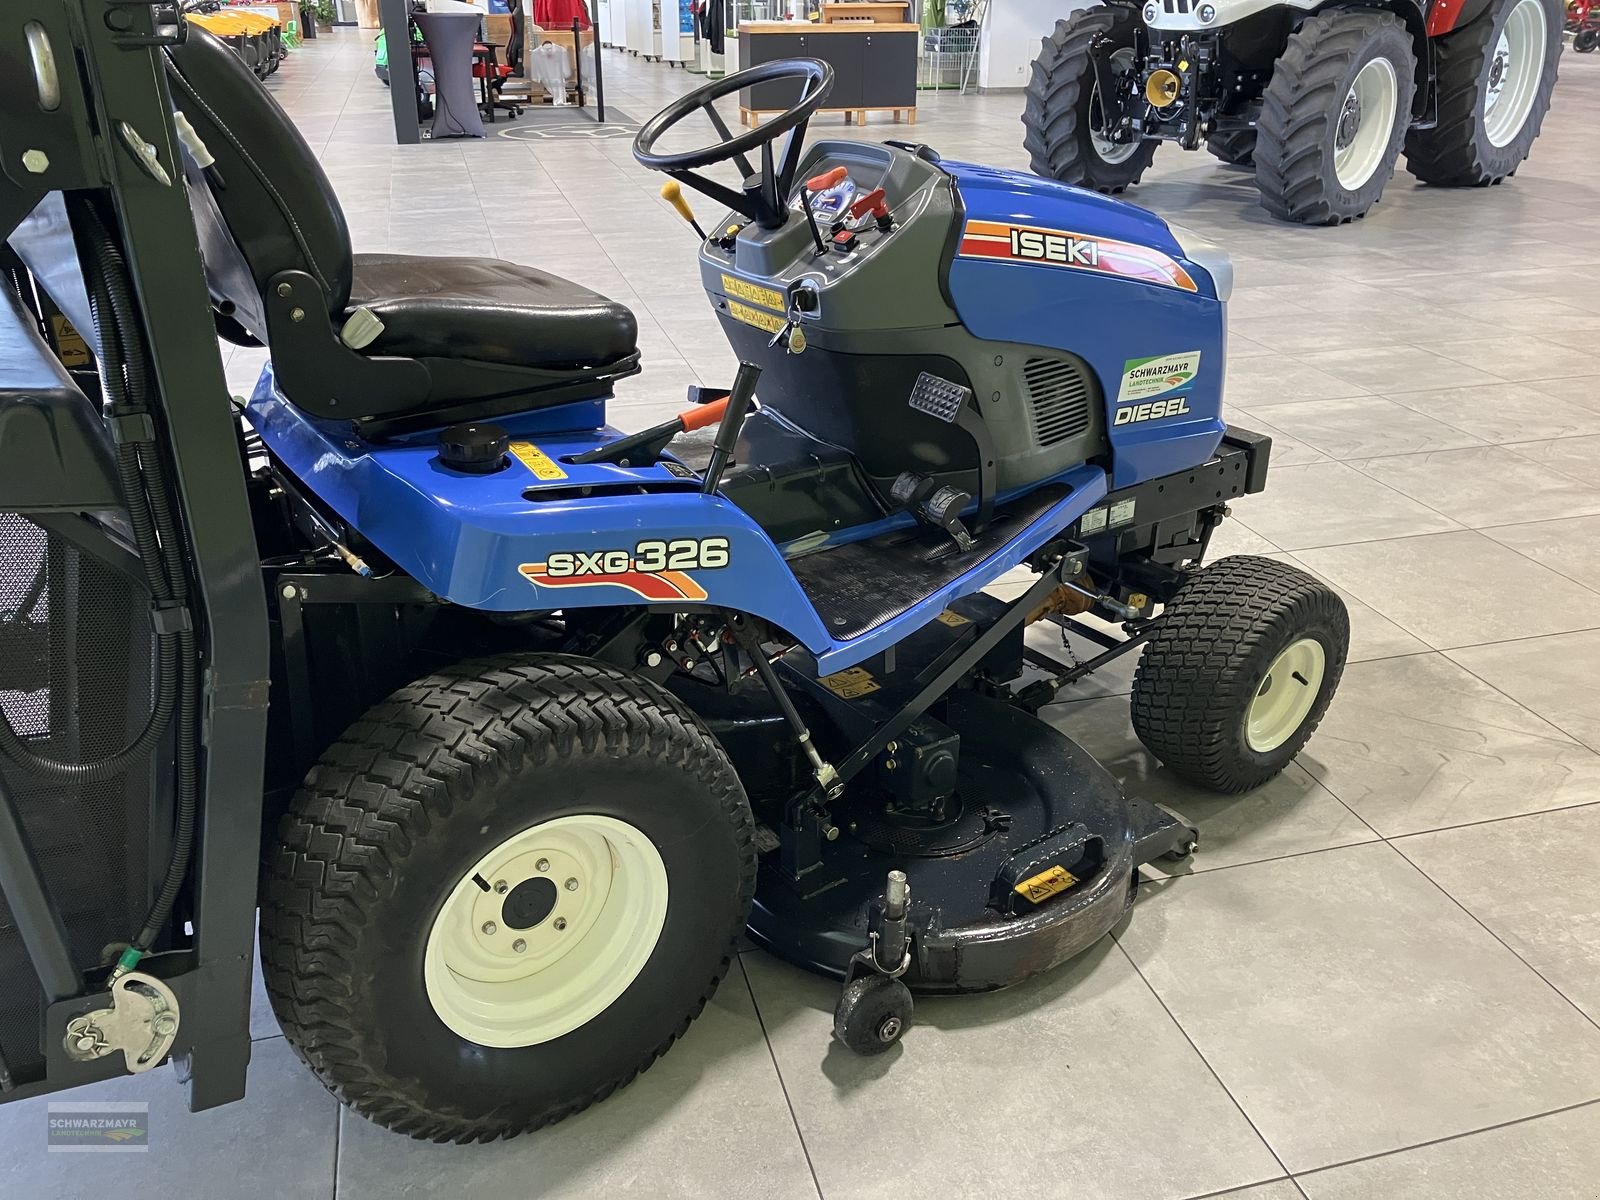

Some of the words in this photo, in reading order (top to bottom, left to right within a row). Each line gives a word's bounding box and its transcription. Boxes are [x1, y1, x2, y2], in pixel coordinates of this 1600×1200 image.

[1010, 228, 1099, 266] ISEKI
[1128, 377, 1165, 388] LANDTECHNIK
[1129, 362, 1189, 379] SCHWARZMAYR
[1112, 396, 1191, 426] DIESEL
[547, 551, 629, 577] SXG
[635, 537, 730, 572] 326
